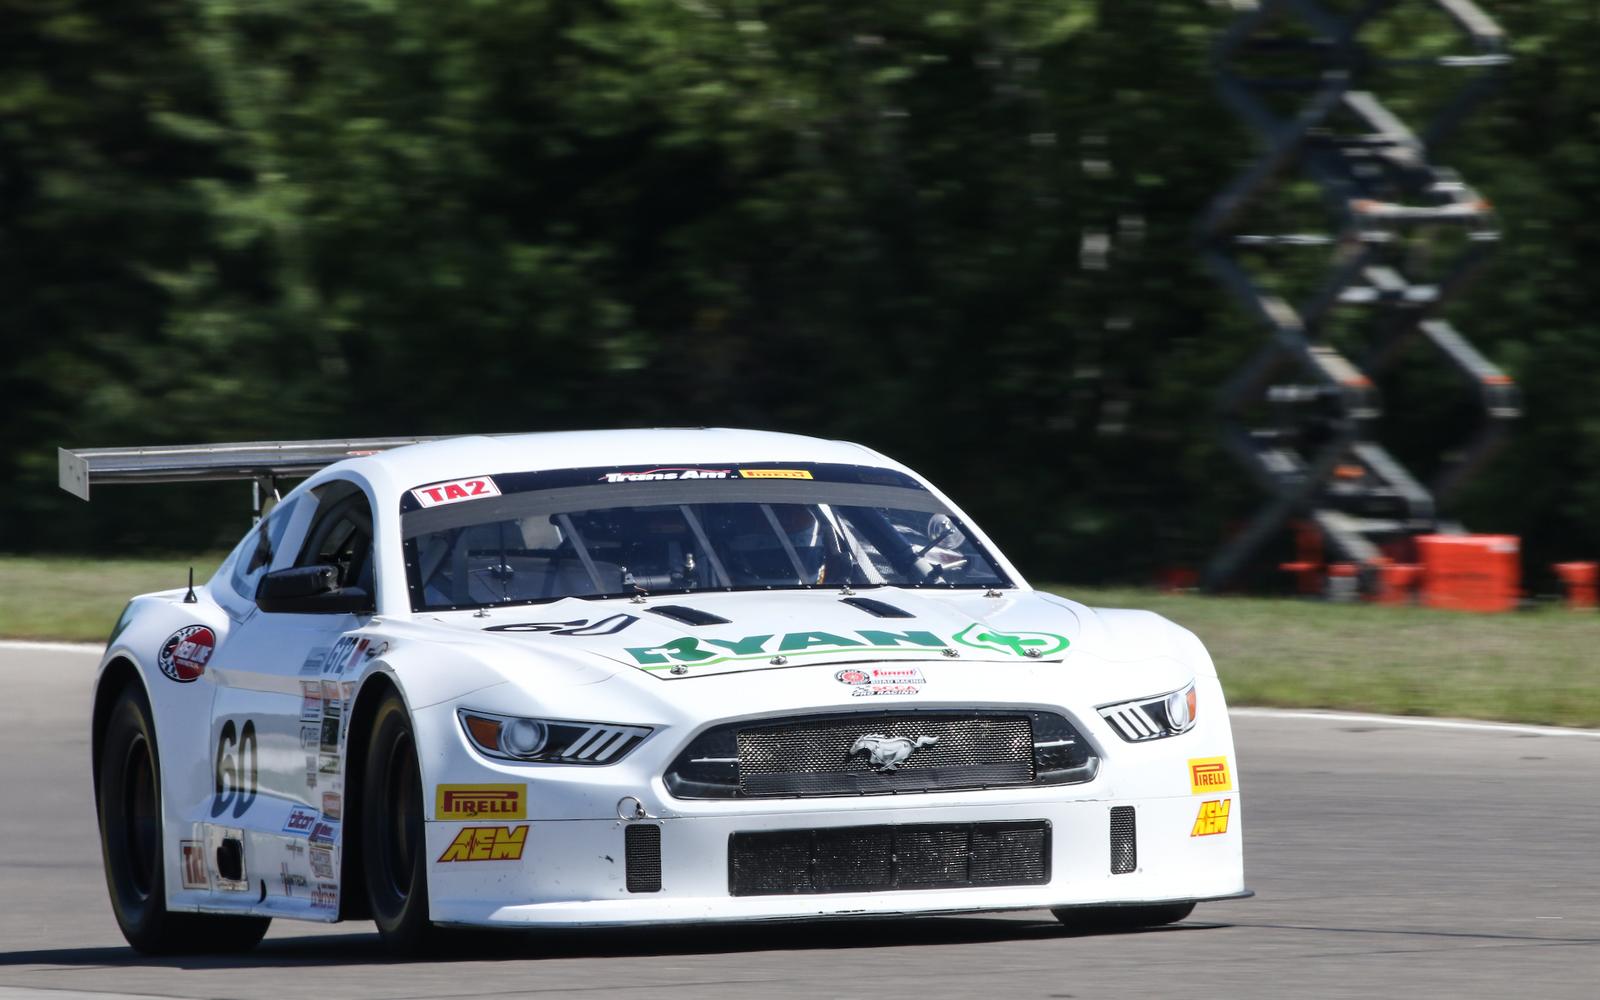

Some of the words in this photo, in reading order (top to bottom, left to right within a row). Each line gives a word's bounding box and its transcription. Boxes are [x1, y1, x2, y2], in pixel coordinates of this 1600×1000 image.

[605, 472, 677, 482] Trans
[680, 470, 727, 480] Am
[421, 480, 490, 502] TA2
[481, 613, 641, 636] 60
[624, 630, 949, 664] RYAN
[211, 719, 258, 819] 60
[1192, 763, 1226, 786] PIRELLI
[443, 790, 519, 812] PIRELLI
[1190, 798, 1232, 837] AEM
[436, 825, 530, 863] AEM
